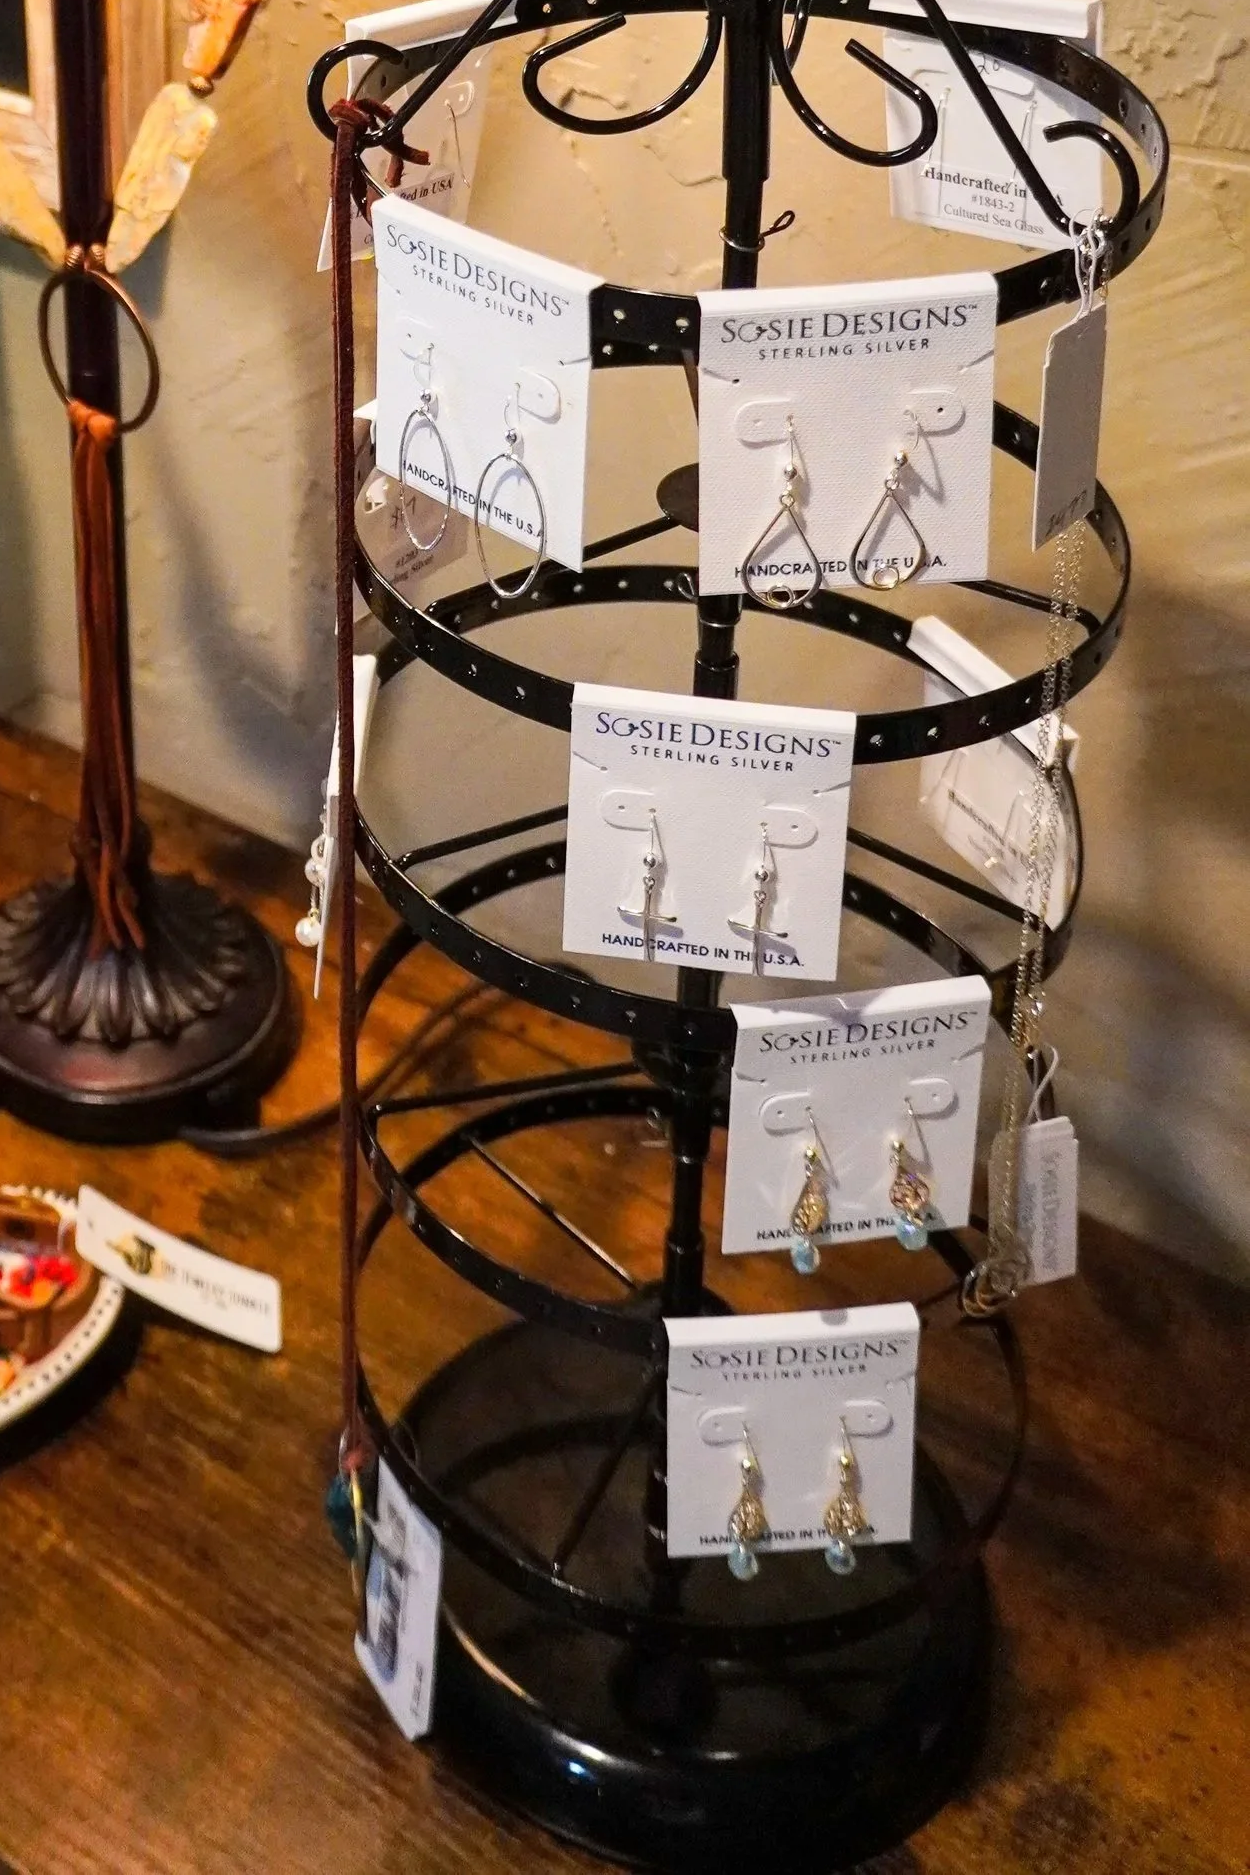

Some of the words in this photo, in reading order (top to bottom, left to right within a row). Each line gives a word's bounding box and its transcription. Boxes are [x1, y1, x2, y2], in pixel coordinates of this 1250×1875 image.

[925, 167, 1010, 195] Handcrafted
[1014, 184, 1027, 199] in
[971, 194, 1015, 213] #1843-2
[943, 203, 989, 223] Cultured
[992, 215, 1011, 229] Sea
[1015, 218, 1045, 235] Glass
[413, 265, 477, 303] STERLING
[485, 297, 534, 326] SILVER
[758, 345, 853, 361] STERLING
[865, 338, 930, 354] SILVER
[479, 499, 491, 514] IN
[493, 505, 513, 525] THE
[631, 744, 720, 766] STERLING
[731, 756, 793, 772] SILVER
[714, 947, 729, 960] IN
[734, 950, 753, 962] TH
[763, 952, 805, 967] U.S.A.
[790, 1047, 871, 1065] STERLING
[880, 1039, 936, 1055] SILVER
